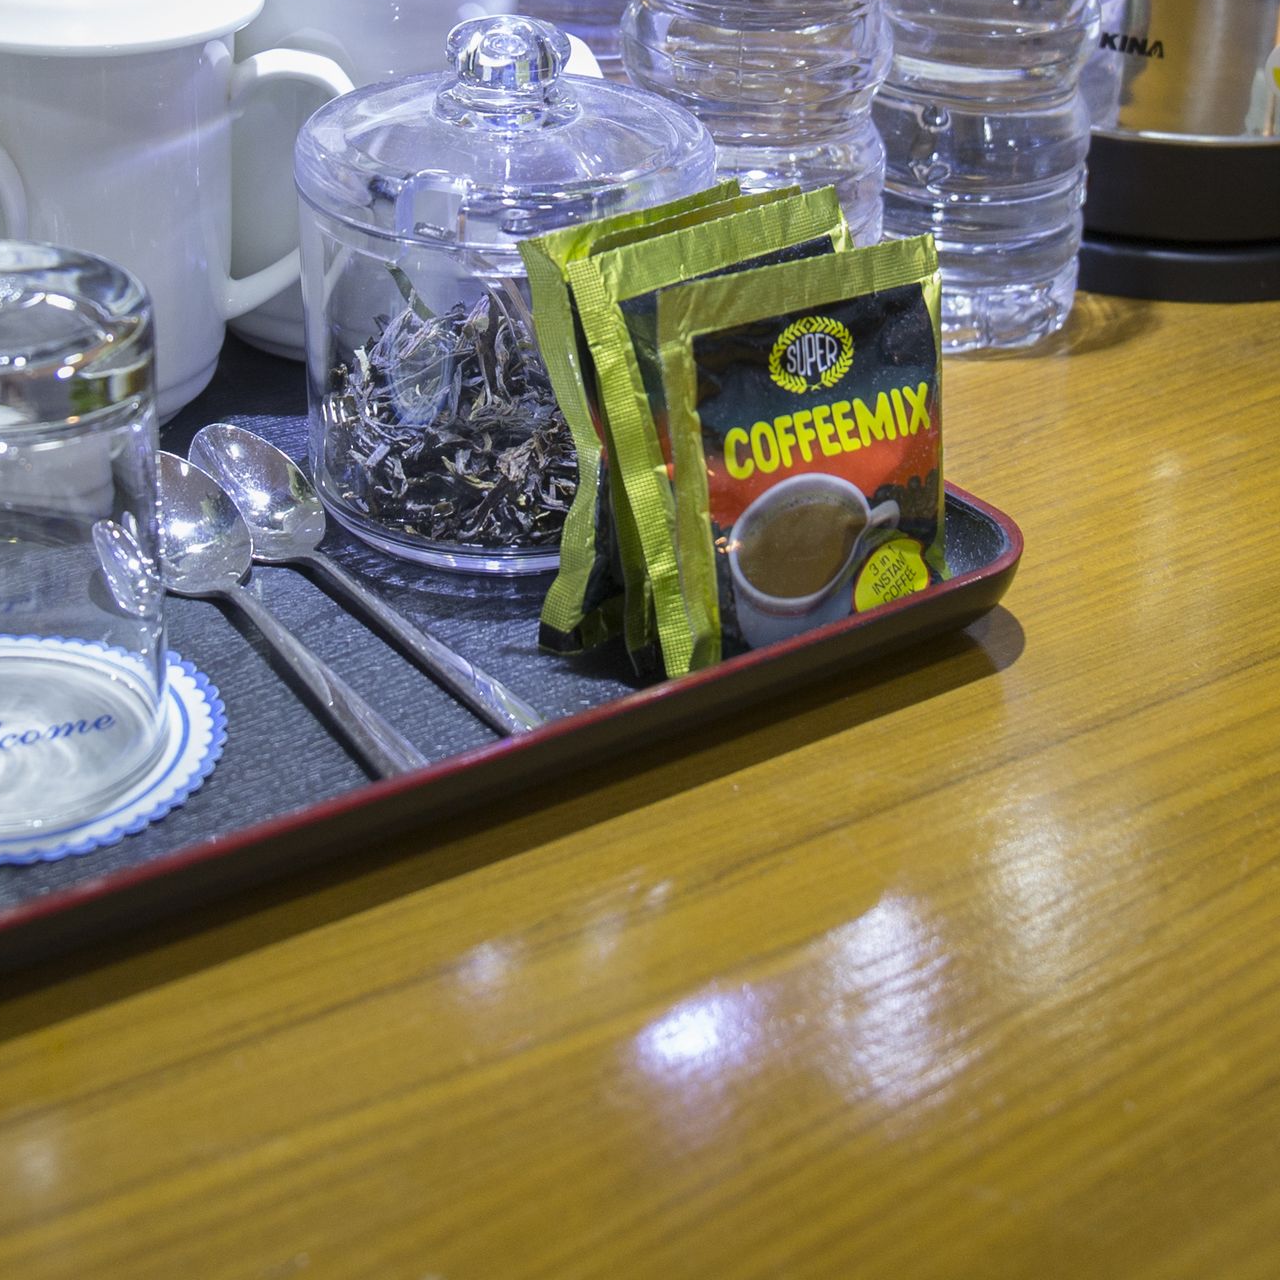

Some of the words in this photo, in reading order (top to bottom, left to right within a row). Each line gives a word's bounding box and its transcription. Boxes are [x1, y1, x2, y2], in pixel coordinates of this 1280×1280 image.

[786, 333, 838, 377] SUPER
[723, 381, 931, 480] COFFEEMIX
[868, 562, 880, 577] 3
[880, 555, 890, 567] in
[882, 565, 917, 603] COFFEE
